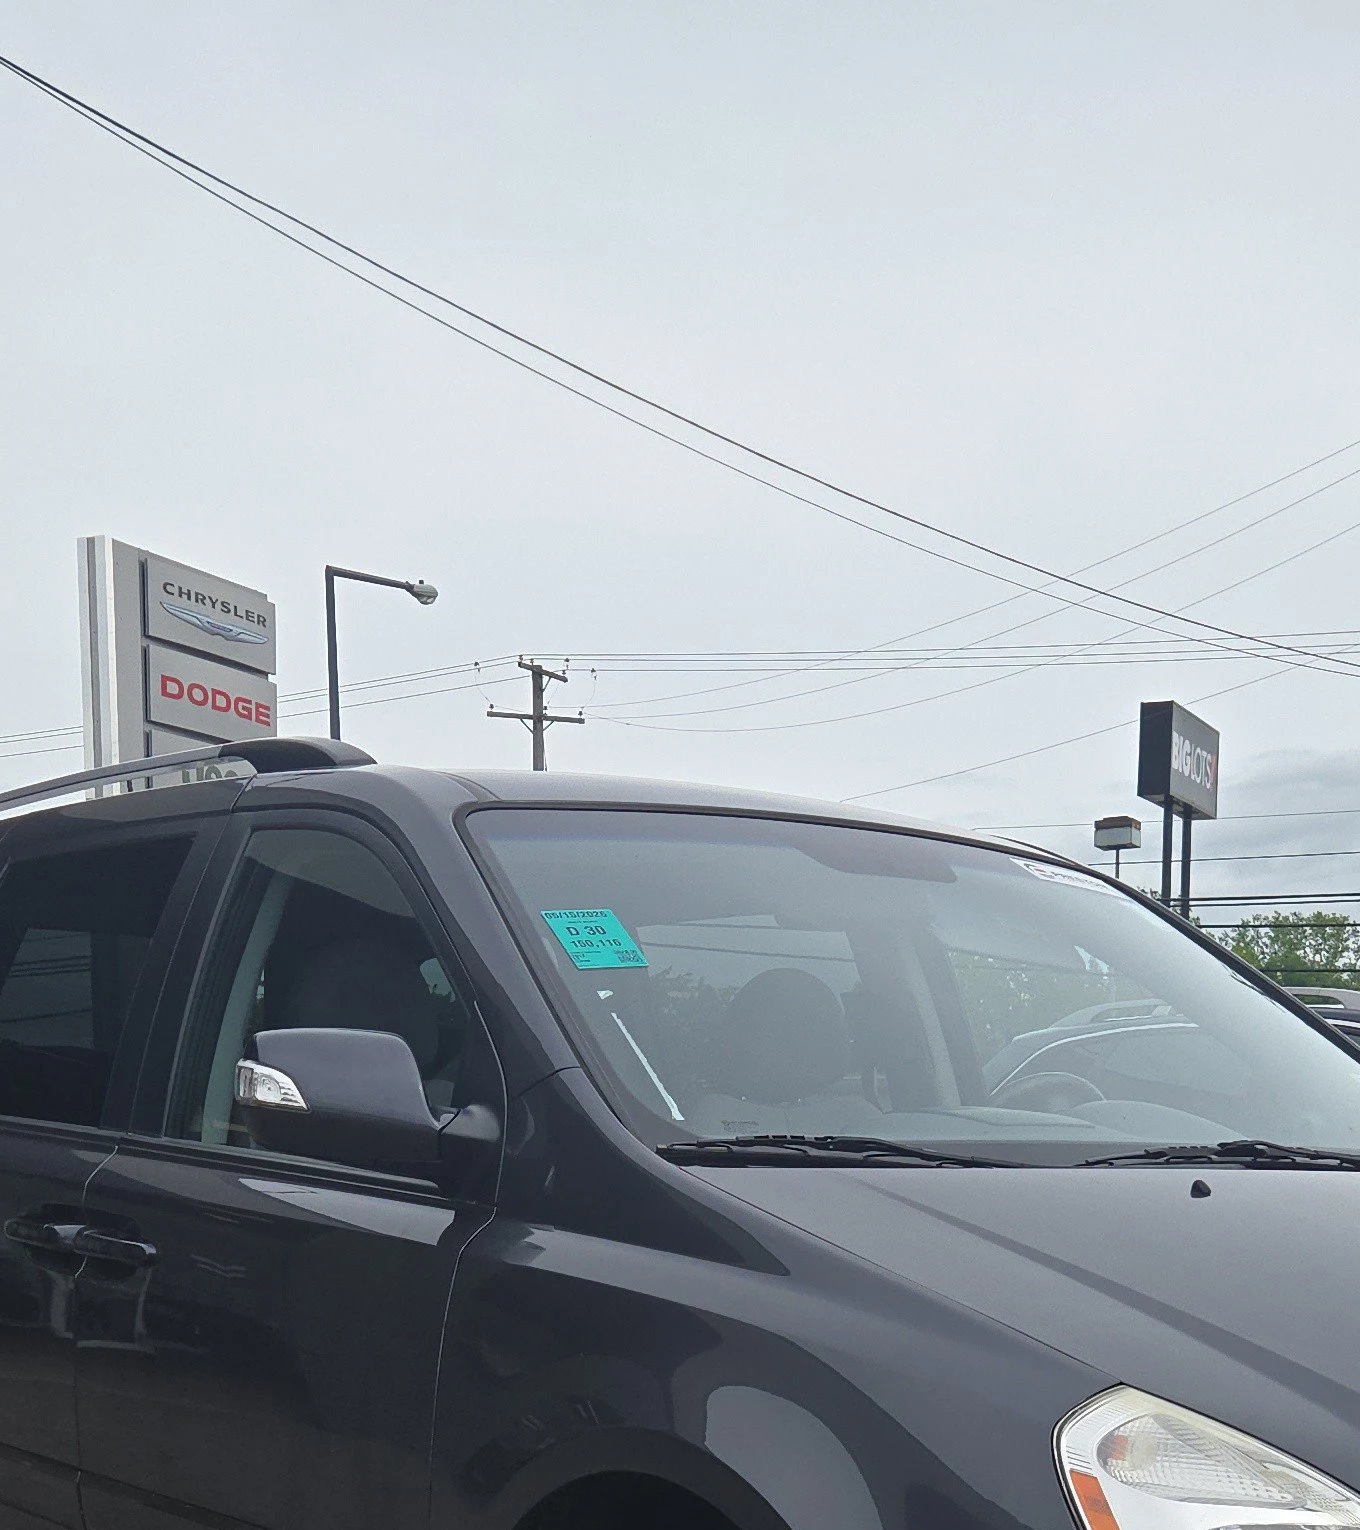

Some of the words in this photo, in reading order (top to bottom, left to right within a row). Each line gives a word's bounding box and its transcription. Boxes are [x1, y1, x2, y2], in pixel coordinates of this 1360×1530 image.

[162, 581, 267, 628] CHRYSLER
[160, 673, 271, 727] DODGE
[565, 926, 580, 936] D
[583, 925, 607, 936] 30
